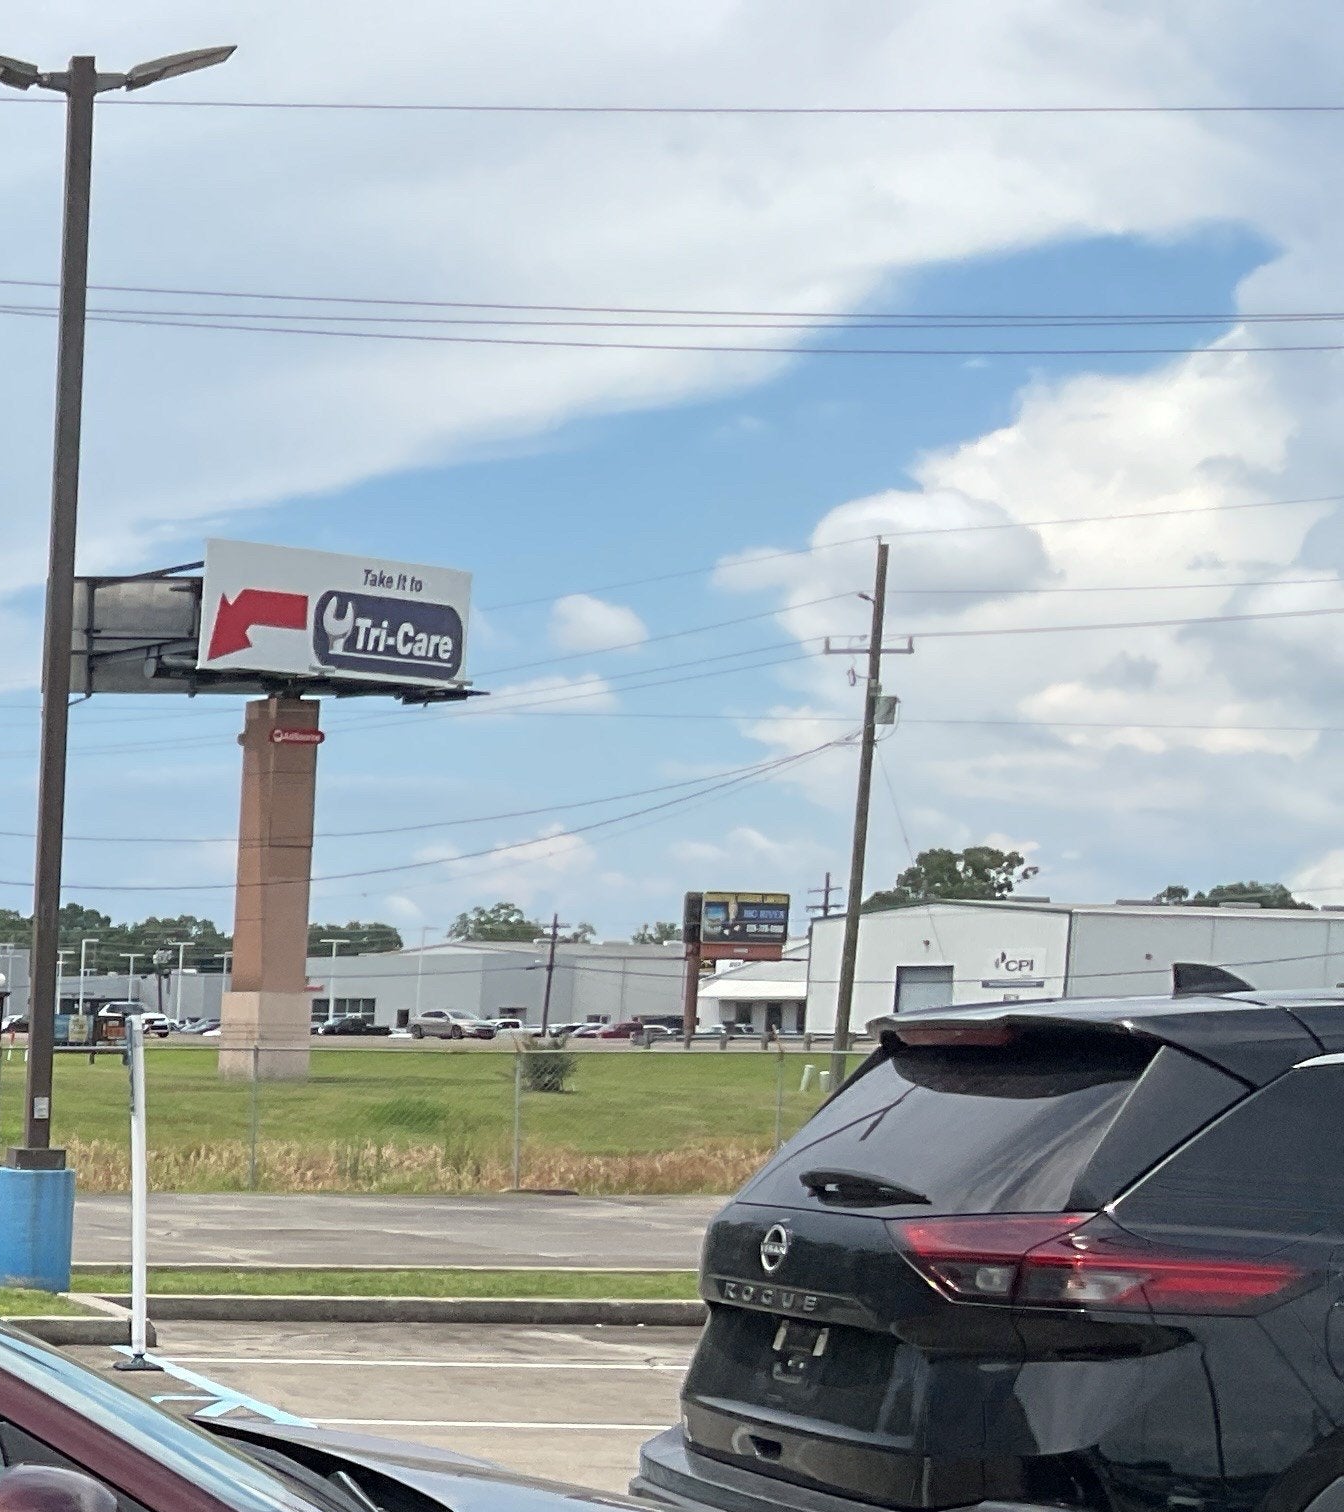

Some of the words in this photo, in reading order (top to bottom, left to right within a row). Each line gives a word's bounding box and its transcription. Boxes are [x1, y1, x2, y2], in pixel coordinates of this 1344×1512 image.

[363, 569, 394, 589] Take
[409, 575, 423, 592] to
[355, 617, 453, 660] Tri-Care
[1005, 959, 1034, 972] CPI
[725, 1283, 817, 1312] ROGUE
